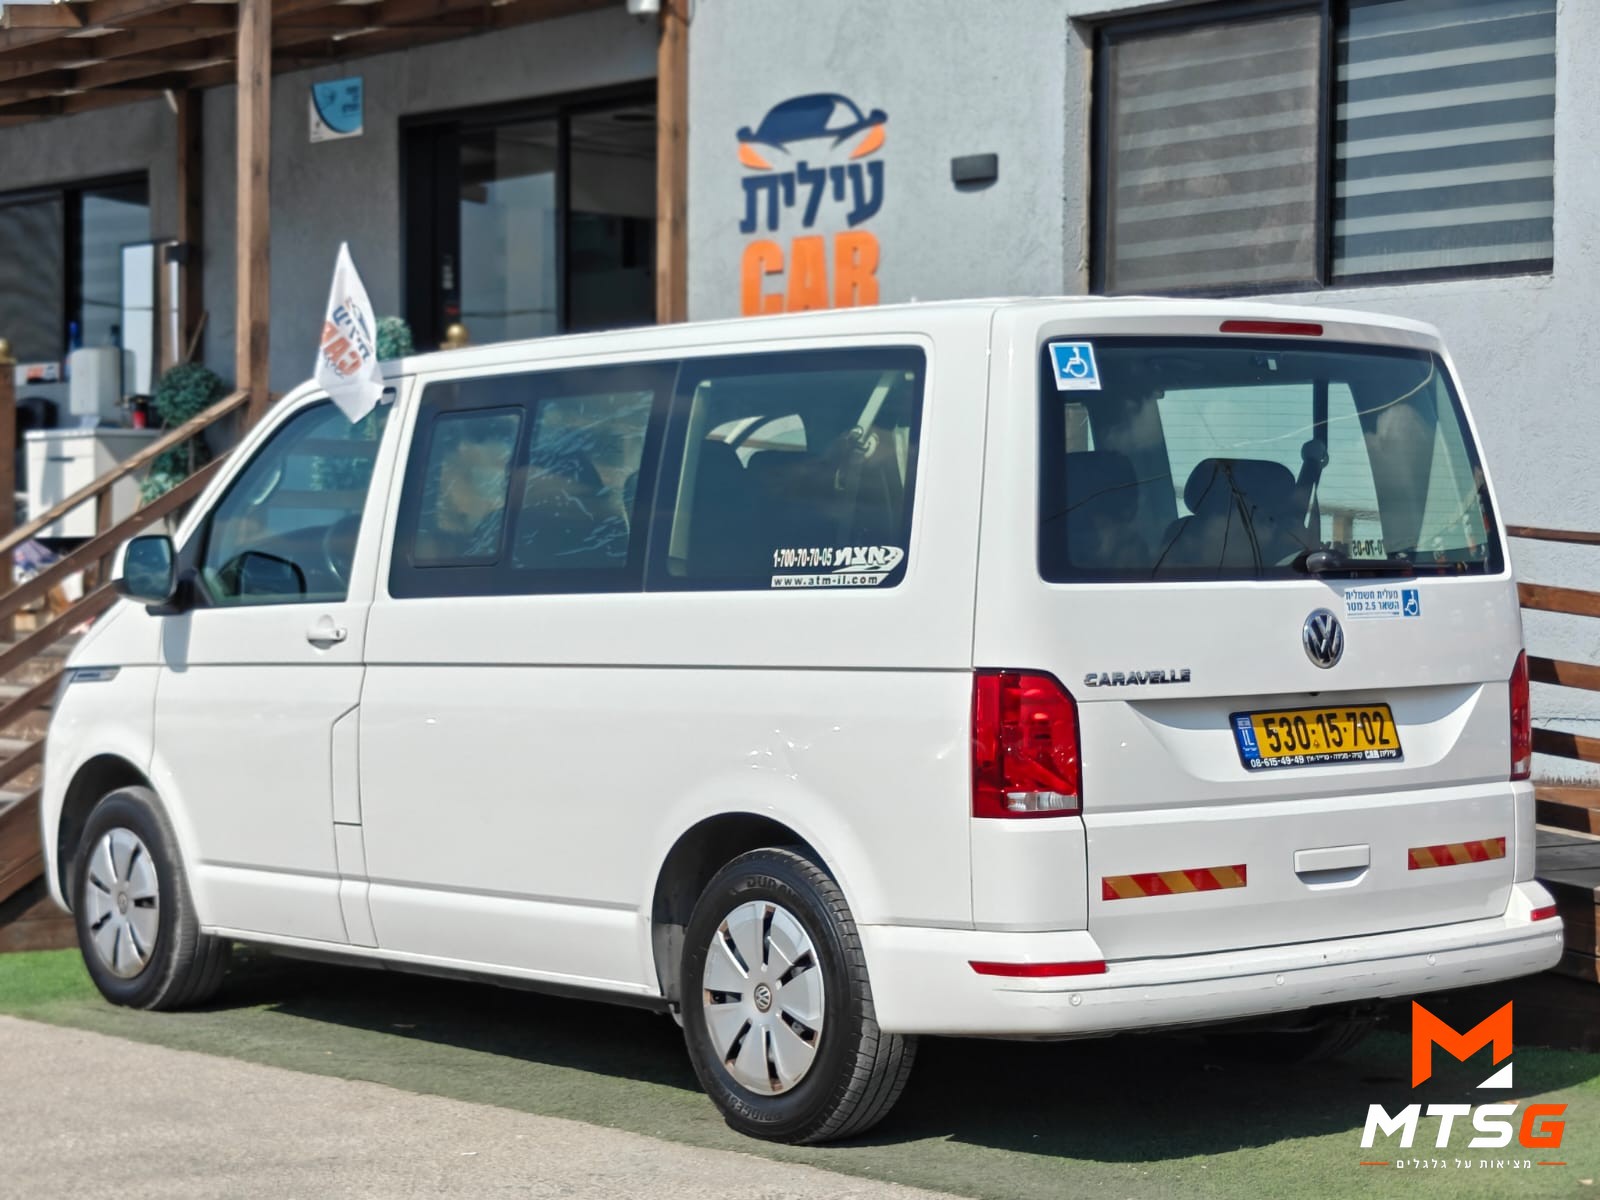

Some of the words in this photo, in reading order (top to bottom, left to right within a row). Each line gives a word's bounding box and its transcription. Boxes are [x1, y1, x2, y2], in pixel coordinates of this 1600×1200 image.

[739, 160, 885, 234] עילית
[741, 230, 880, 317] CAR
[773, 547, 833, 568] 1-700-70-70-05
[773, 575, 878, 586] www.atm-il.com
[1345, 588, 1375, 601] חשמלית
[1377, 588, 1399, 600] מעלית
[1346, 602, 1363, 611] מטר
[1365, 601, 1376, 611] 2.5
[1379, 600, 1400, 610] השאר
[1084, 669, 1191, 687] CARAVELLE
[1250, 754, 1305, 768] 08-615-49-49
